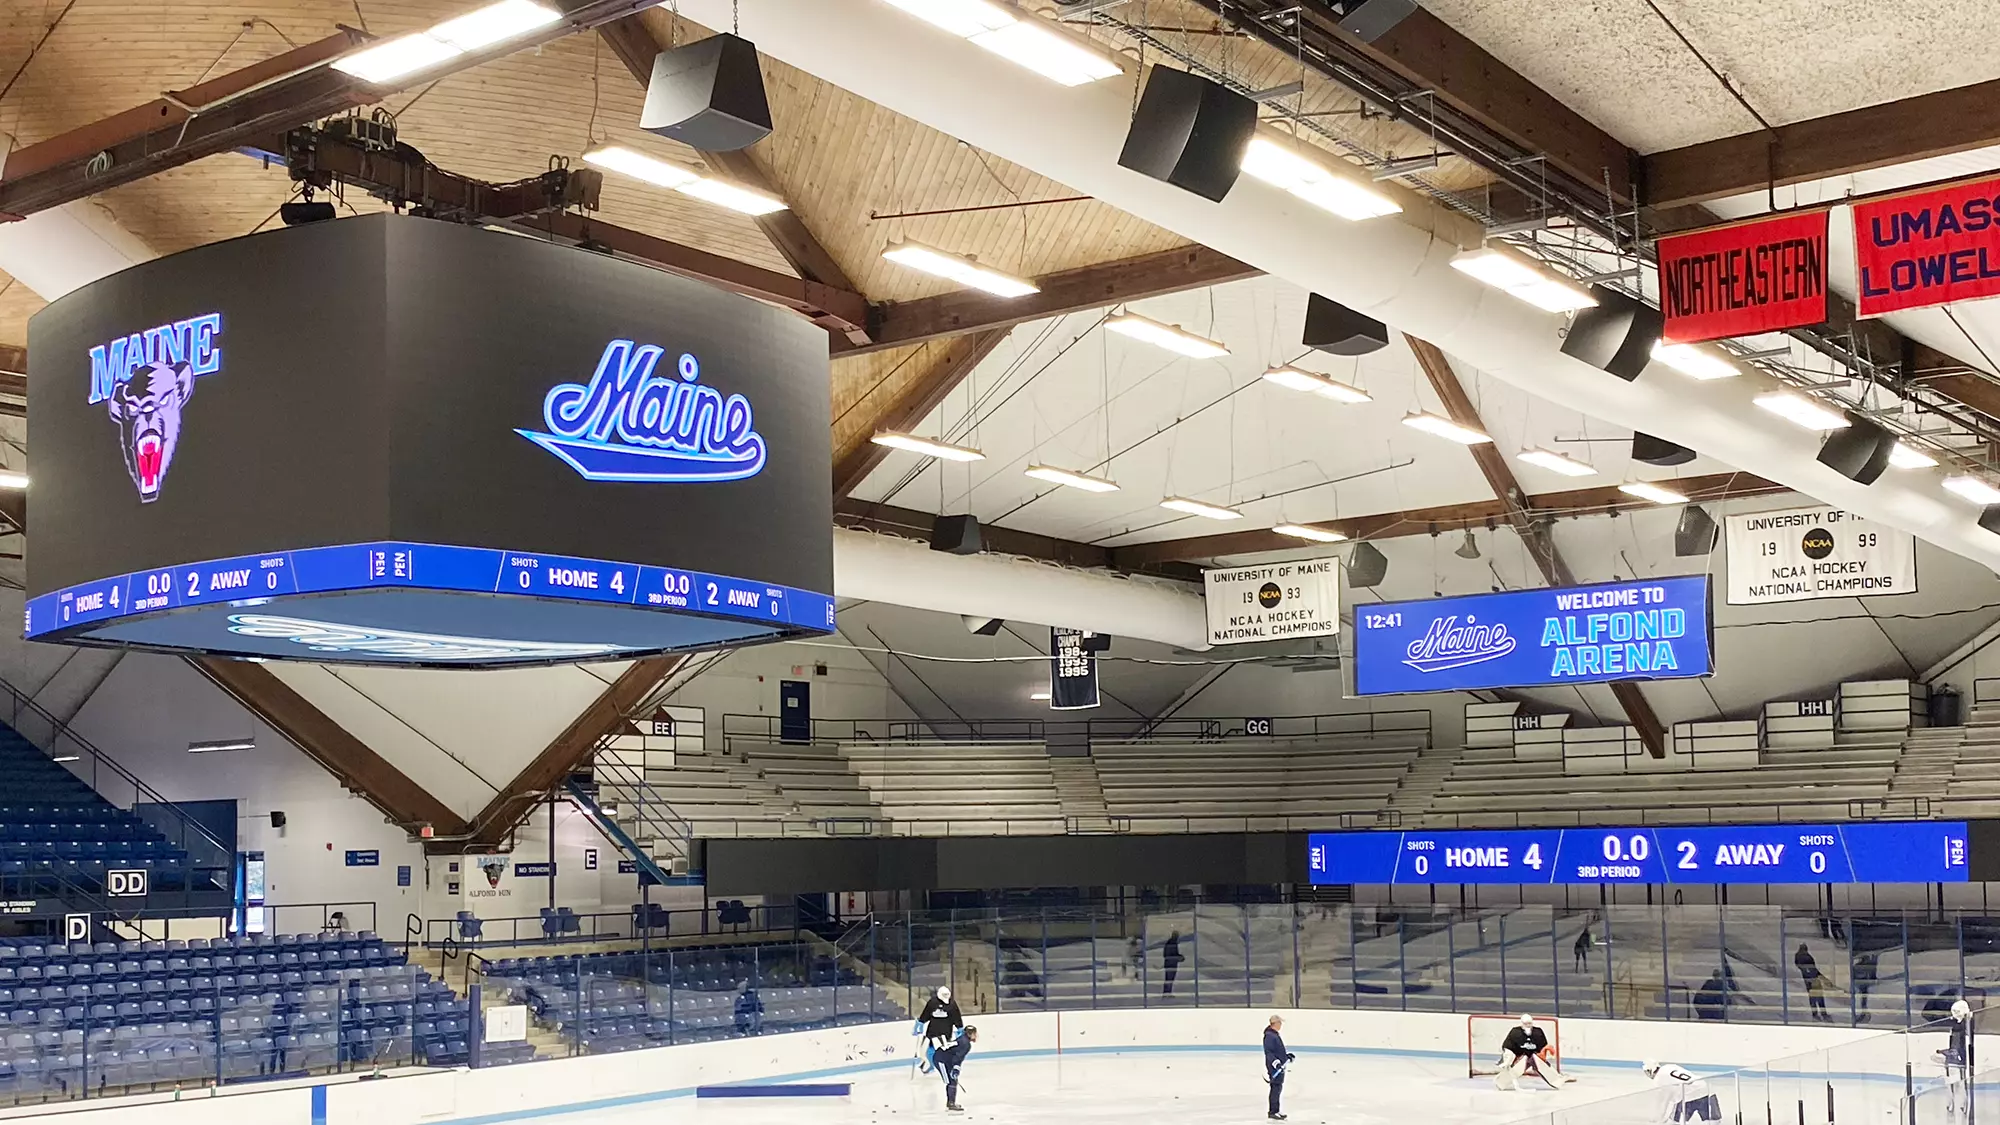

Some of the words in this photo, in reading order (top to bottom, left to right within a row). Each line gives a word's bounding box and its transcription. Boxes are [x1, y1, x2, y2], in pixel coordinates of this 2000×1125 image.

[1664, 235, 1823, 319] NORTHEASTERN
[88, 312, 222, 404] MAINE
[543, 338, 768, 466] Maine
[1747, 512, 1821, 531] UNIVERSITY
[1827, 510, 1845, 523] OF
[1762, 542, 1777, 556] 19
[1803, 538, 1833, 549] NCAA
[1858, 533, 1877, 548] 99
[260, 557, 284, 569] SHOTS
[375, 551, 386, 577] PEN
[394, 552, 406, 577] PEN
[511, 557, 539, 569] SHOTS
[1214, 568, 1274, 583] UNIVERSITY
[1278, 566, 1293, 577] OF
[1297, 562, 1331, 575] MAINE
[1772, 567, 1807, 579] NCAA
[1813, 561, 1867, 575] HOCKEY
[147, 572, 171, 595] 0.0
[187, 571, 200, 597] 2
[210, 569, 251, 591] AWAY
[267, 571, 277, 590] 0
[519, 571, 531, 589] 0
[548, 567, 599, 589] HOME
[609, 570, 625, 595] 4
[663, 572, 690, 595] 0.0
[1749, 580, 1812, 597] NATIONAL
[1817, 576, 1893, 592] CHAMPIONS
[76, 591, 104, 614] HOME
[109, 585, 120, 609] 4
[146, 596, 169, 609] PERIOD
[647, 593, 662, 604] 3RD
[662, 594, 687, 607] PERIOD
[706, 582, 719, 606] 2
[727, 588, 760, 608] AWAY
[766, 588, 783, 599] SHOTS
[1242, 591, 1254, 604] 19
[1259, 590, 1281, 600] NCAA
[1287, 587, 1301, 599] 93
[1556, 590, 1639, 611] WELCOME
[1641, 586, 1665, 604] TO
[63, 605, 70, 622] 0
[770, 600, 779, 617] 0
[1230, 615, 1263, 627] NCAA
[1268, 609, 1314, 623] HOCKEY
[1214, 627, 1266, 640] NATIONAL
[1271, 620, 1332, 635] CHAMPIONS
[1364, 612, 1403, 629] 12:41
[1540, 607, 1686, 648] ALFOND
[1406, 615, 1517, 663] Maine
[1550, 640, 1679, 678] ARENA
[1059, 666, 1089, 677] 1995
[1800, 701, 1824, 715] HH
[654, 722, 670, 735] EE
[1246, 719, 1269, 735] GG
[1519, 716, 1539, 729] HH
[1406, 840, 1435, 852] SHOTS
[1603, 834, 1649, 861] 0.0
[1799, 835, 1835, 846] SHOTS
[586, 851, 596, 867] E
[1311, 847, 1321, 870] PEN
[1445, 847, 1509, 868] HOME
[1522, 843, 1543, 870] 4
[1676, 841, 1698, 870] 2
[1715, 843, 1785, 866] AWAY
[1809, 851, 1826, 874] 0
[1950, 839, 1965, 866] PEN
[1415, 855, 1429, 876] 0
[1577, 866, 1600, 878] 3RD
[1600, 866, 1641, 878] PERIOD
[111, 873, 145, 893] DD
[69, 918, 87, 940] D
